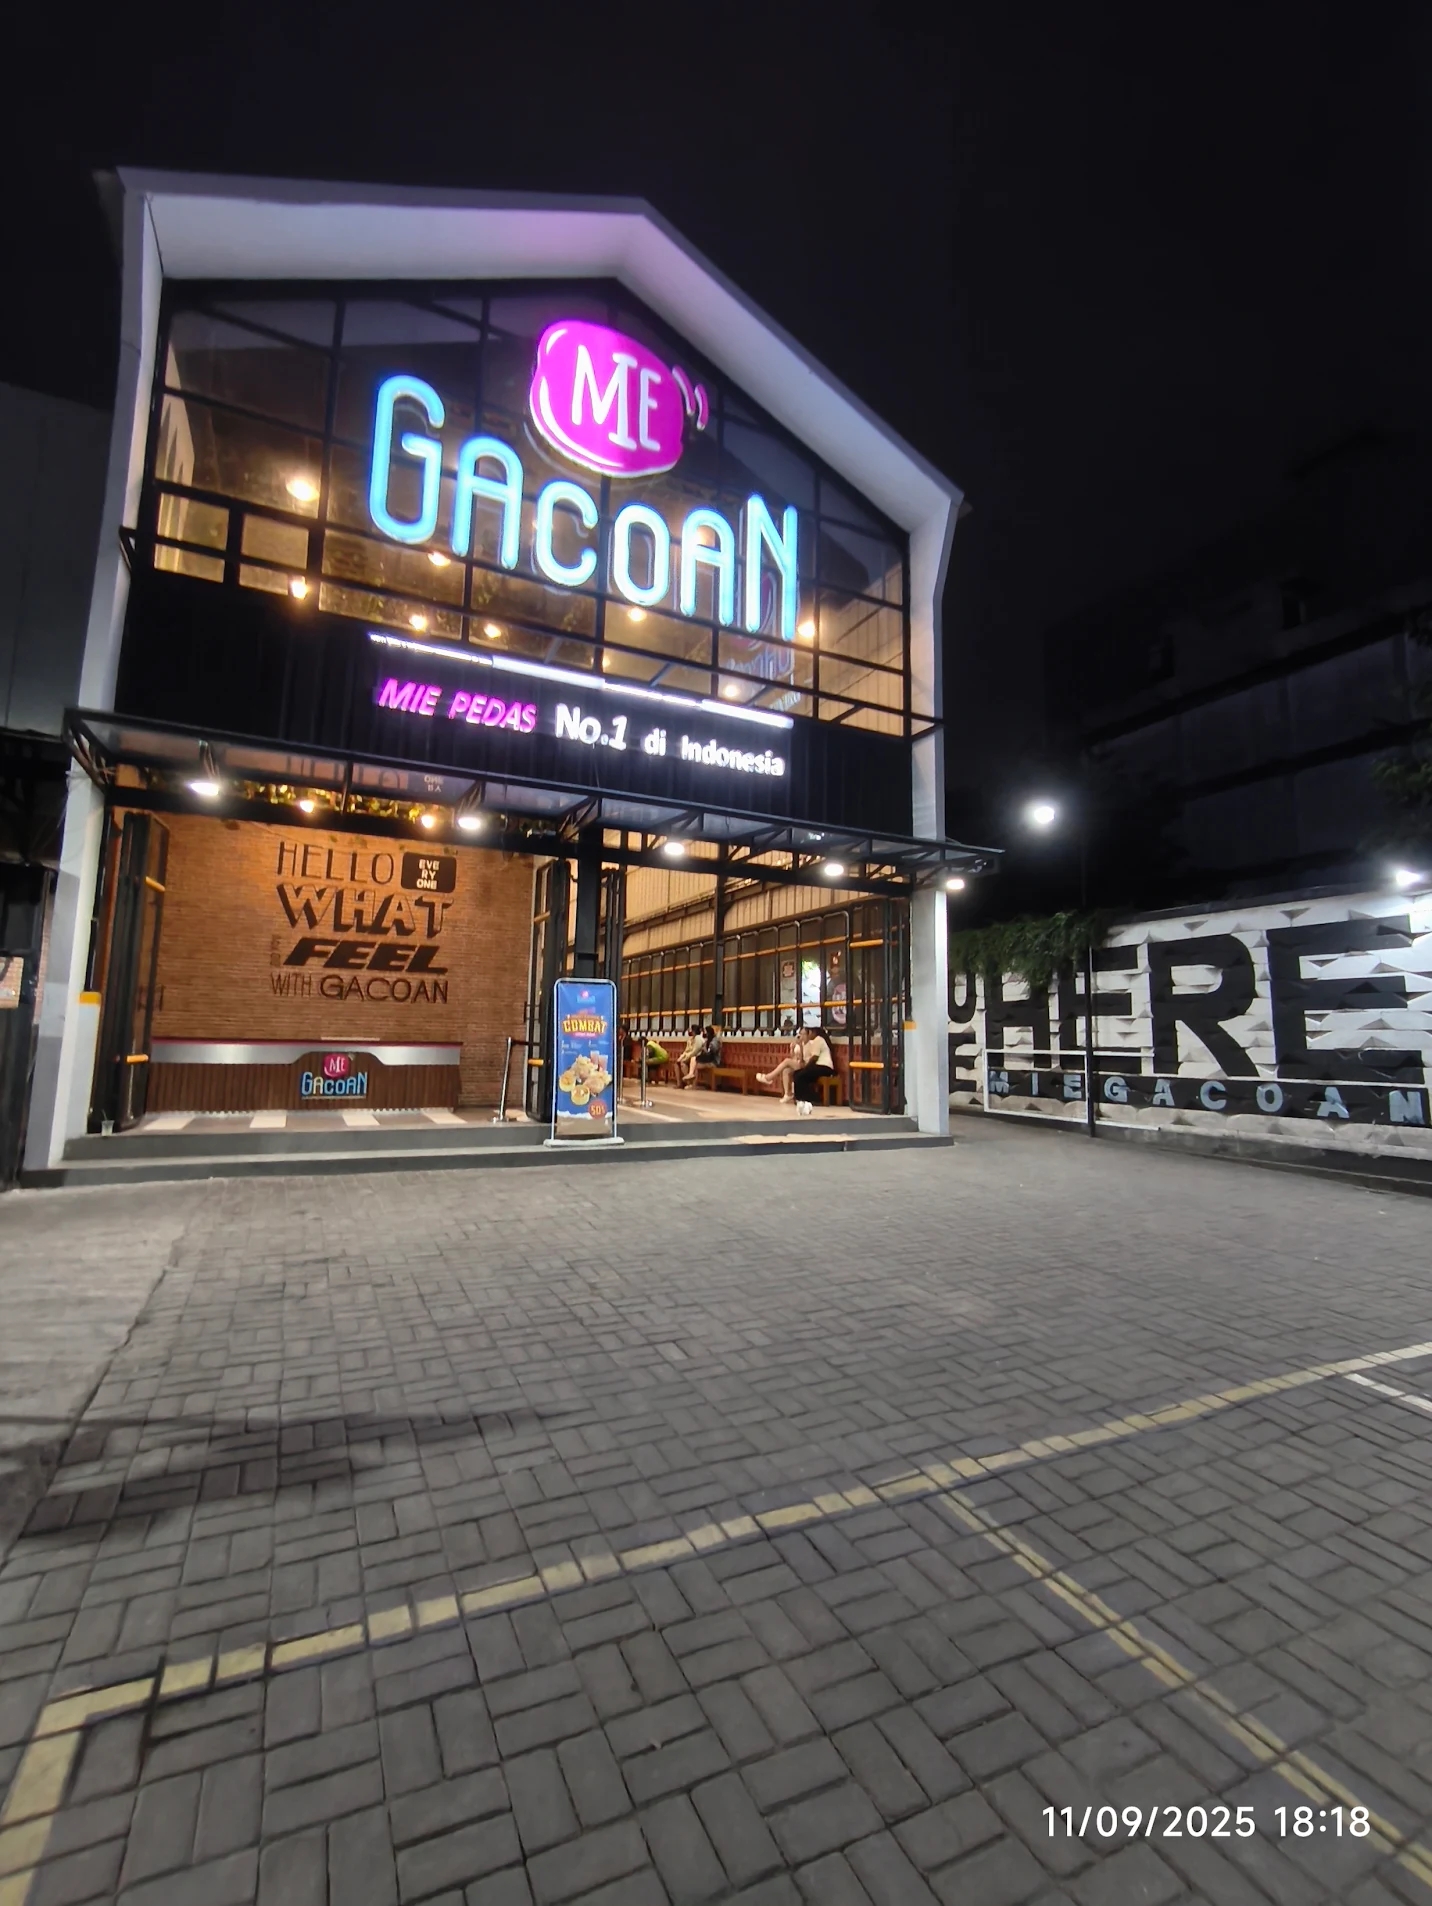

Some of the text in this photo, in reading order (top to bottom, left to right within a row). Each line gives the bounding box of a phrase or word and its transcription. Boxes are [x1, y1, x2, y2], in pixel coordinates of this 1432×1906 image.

[368, 374, 799, 642] GACOAN
[377, 678, 786, 777] MIE PEDAS No.1 di Indonesia
[277, 841, 394, 885] HELLO
[276, 882, 455, 939] WHAT
[283, 937, 449, 974] FEEL
[271, 972, 449, 1004] WITH GACOAN
[301, 1071, 368, 1095] GACOAN
